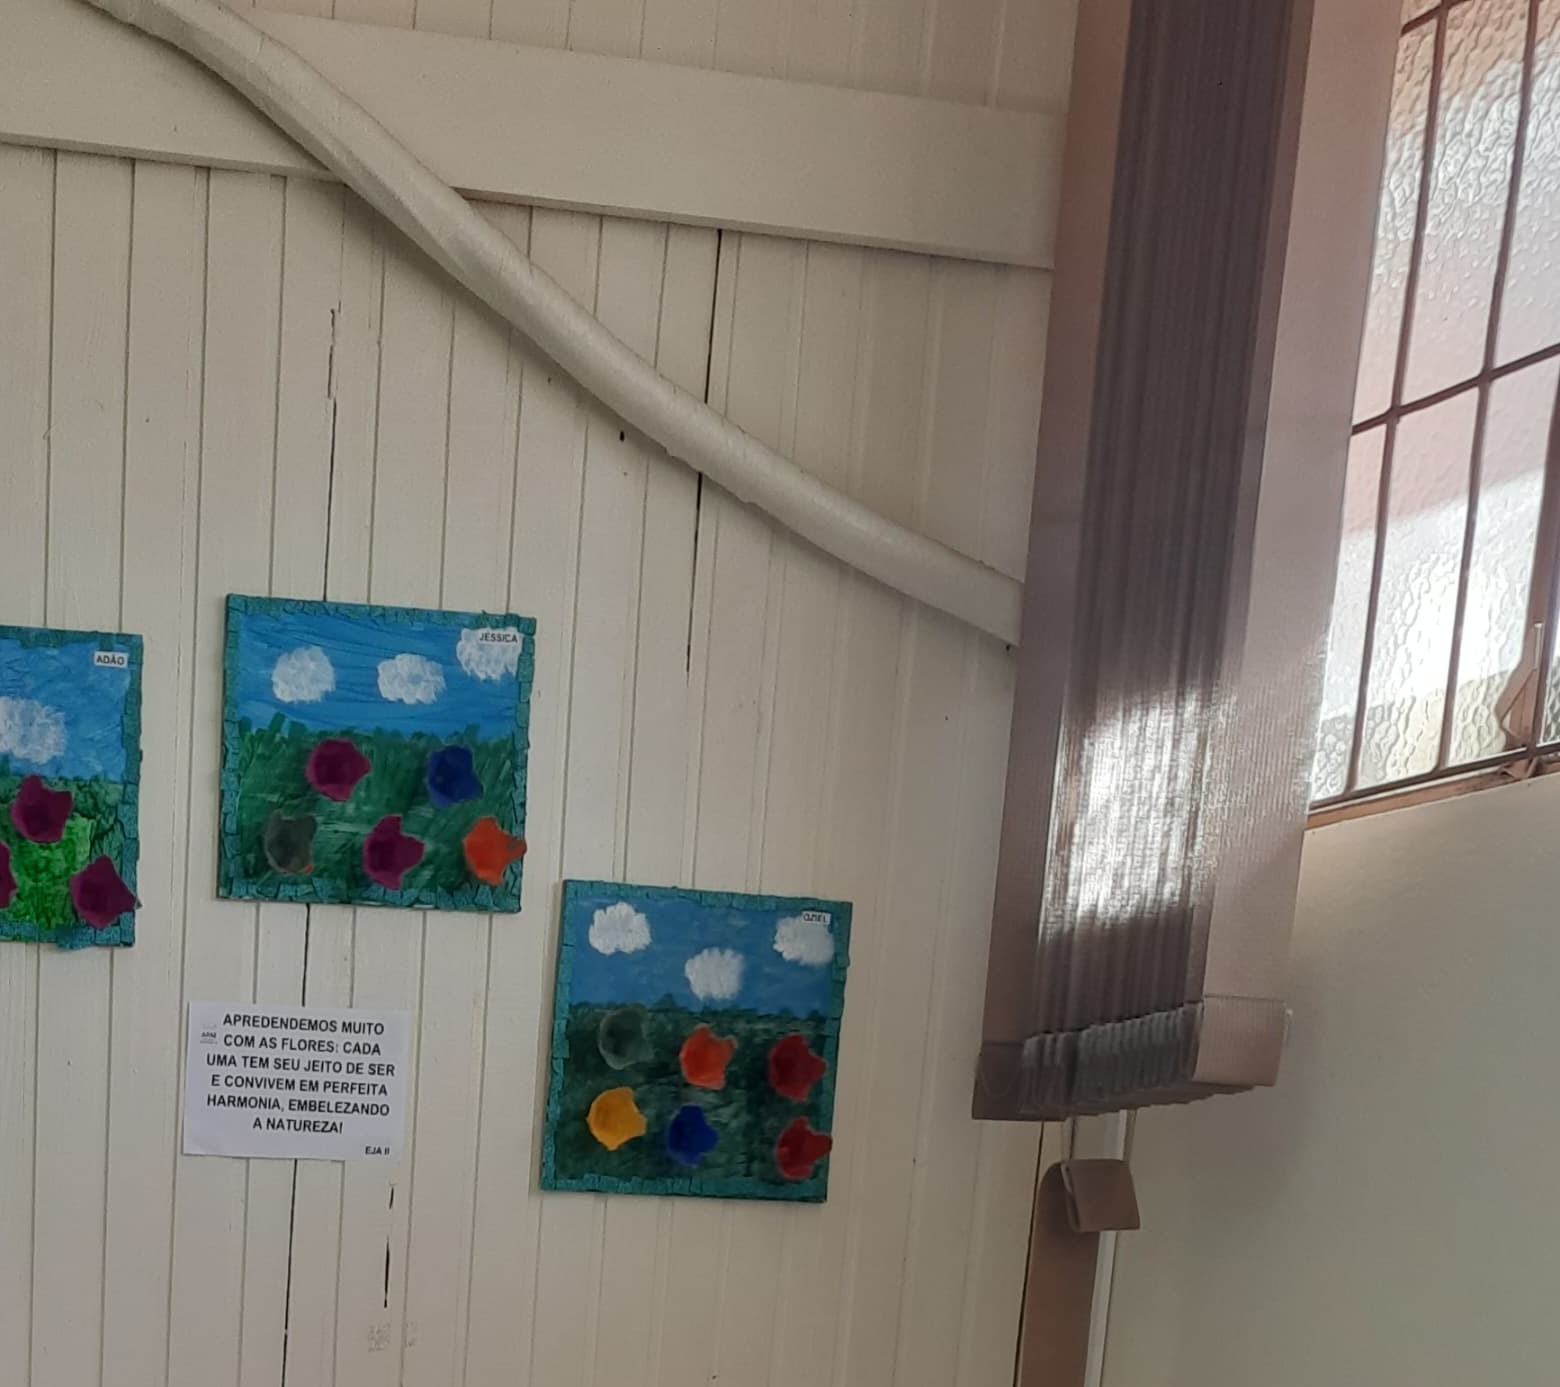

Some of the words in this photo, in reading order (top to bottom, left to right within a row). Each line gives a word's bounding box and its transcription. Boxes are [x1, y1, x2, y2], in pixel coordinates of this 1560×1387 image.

[223, 1014, 337, 1032] APREDENDEMOS
[341, 1021, 384, 1035] MUITO
[224, 1034, 254, 1048] COM
[259, 1037, 277, 1049] AS
[343, 1042, 381, 1056] CADA
[206, 1054, 236, 1067] UMA
[241, 1056, 269, 1069] TEM
[273, 1058, 300, 1071] SEU
[304, 1060, 342, 1073] JEITO
[346, 1062, 364, 1074] DE
[368, 1064, 395, 1076] SER
[212, 1074, 220, 1086] E
[224, 1075, 295, 1091] CONVIVEM
[300, 1080, 318, 1092] EM
[324, 1081, 387, 1096] PERFEITA
[207, 1094, 284, 1112] HARMONIA,
[289, 1099, 389, 1116] EMBELEZANDO
[253, 1118, 262, 1129] A
[266, 1118, 343, 1134] NATUREZA!
[365, 1146, 383, 1155] EJA
